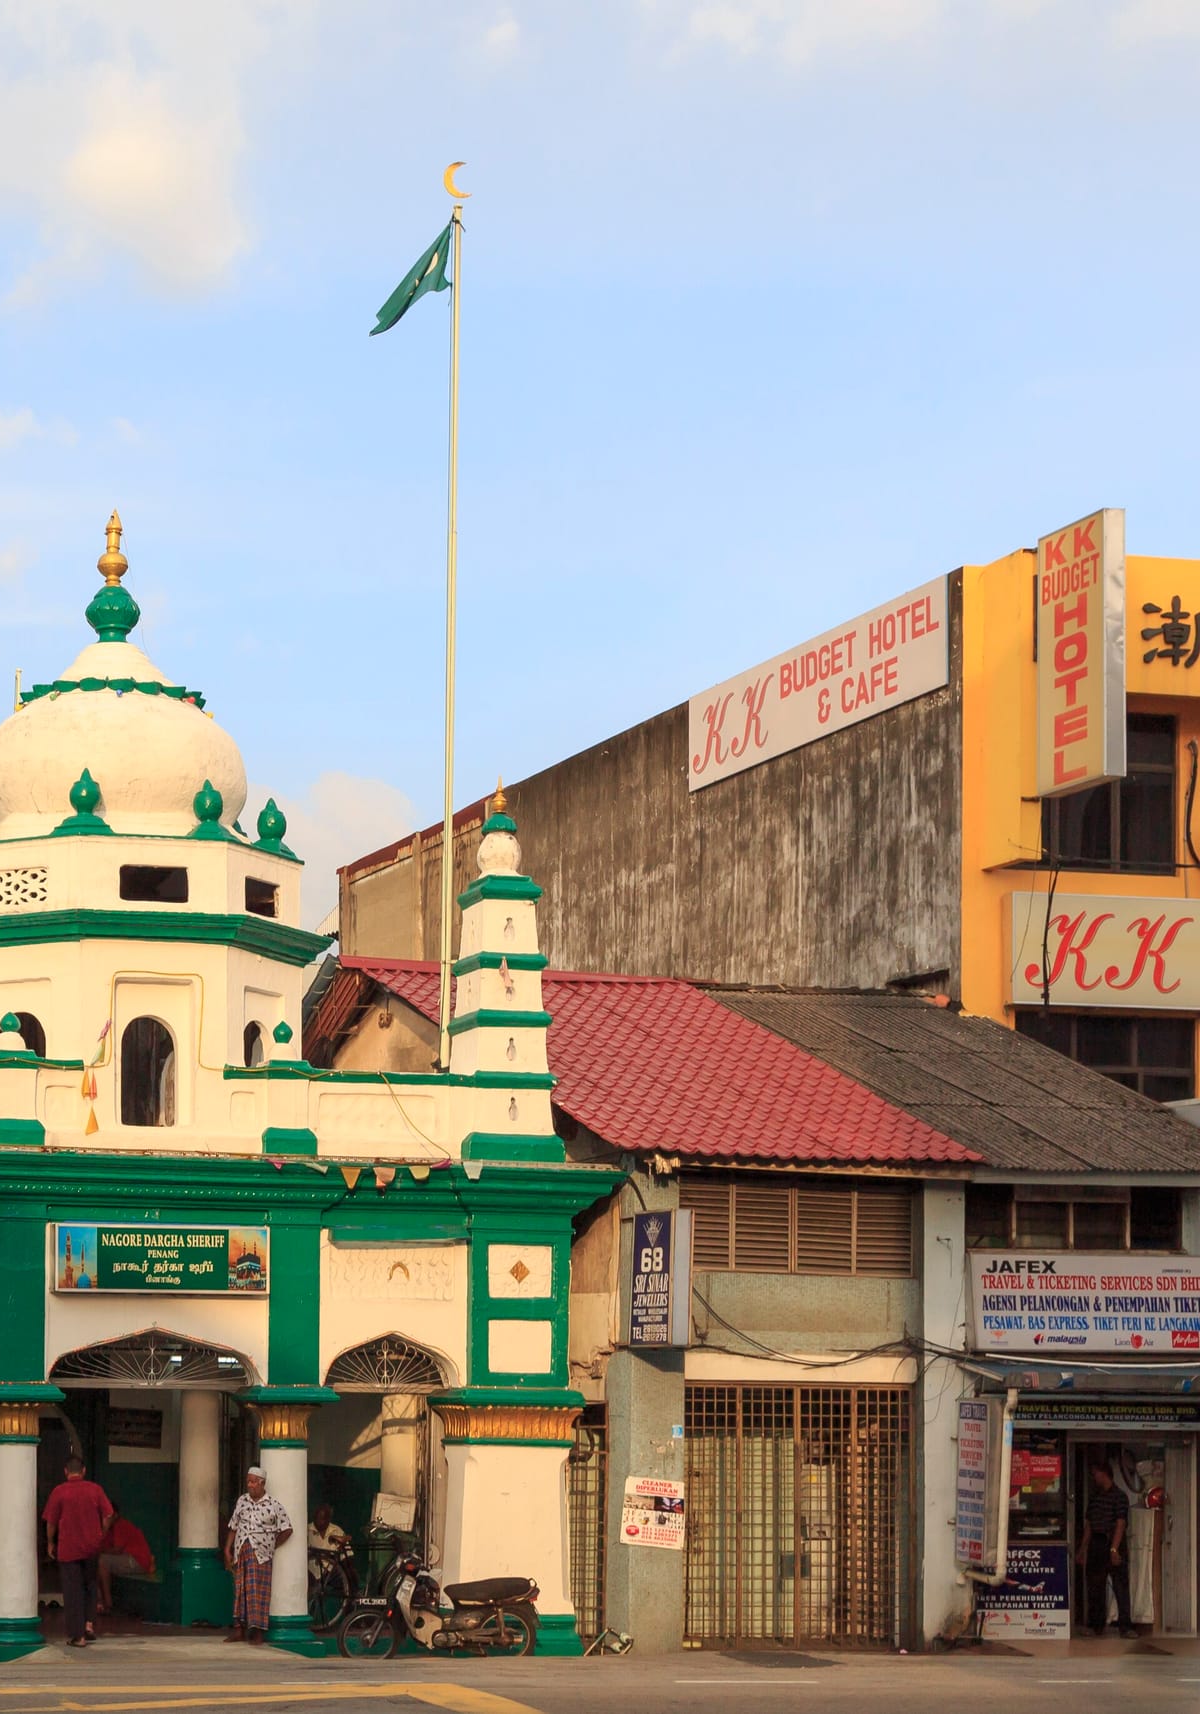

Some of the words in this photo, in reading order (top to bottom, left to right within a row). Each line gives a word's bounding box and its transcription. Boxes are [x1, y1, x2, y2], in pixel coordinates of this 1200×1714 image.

[1042, 552, 1100, 606] BUDGET
[779, 630, 856, 699] BUDGET
[869, 596, 939, 658] HOTEL
[817, 688, 831, 724] &
[841, 656, 899, 714] CAFE
[1054, 596, 1088, 785] HOTEL
[102, 1233, 142, 1247] NAGORE
[144, 1234, 185, 1248] DARGHA
[187, 1234, 225, 1248] SHERIFF
[147, 1250, 179, 1259] PENANG
[641, 1247, 663, 1272] 68
[153, 1261, 183, 1274] தர்கா
[986, 1260, 1056, 1274] JAFEX
[634, 1274, 646, 1293] SRI
[647, 1273, 668, 1292] SINAR
[981, 1275, 1024, 1289] TRAVEL
[1027, 1275, 1034, 1289] &
[1038, 1276, 1097, 1290] TICKETING
[1101, 1276, 1153, 1290] SERVICES
[1157, 1277, 1177, 1291] SDN
[634, 1293, 668, 1307] JEWELLERS
[983, 1295, 1016, 1311] AGENSI
[1020, 1295, 1090, 1312] PELANCONGAN
[1093, 1296, 1101, 1311] &
[1105, 1296, 1170, 1312] PENEMPAHAN
[1028, 1316, 1045, 1330] BAS
[1094, 1316, 1119, 1330] TIKET
[1121, 1317, 1142, 1331] FERI
[1144, 1317, 1156, 1331] KE
[1159, 1317, 1200, 1331] LANGKAW
[633, 1327, 642, 1340] TEL
[636, 1485, 678, 1494] DIPERLUKAN
[642, 1480, 672, 1488] CLEANER
